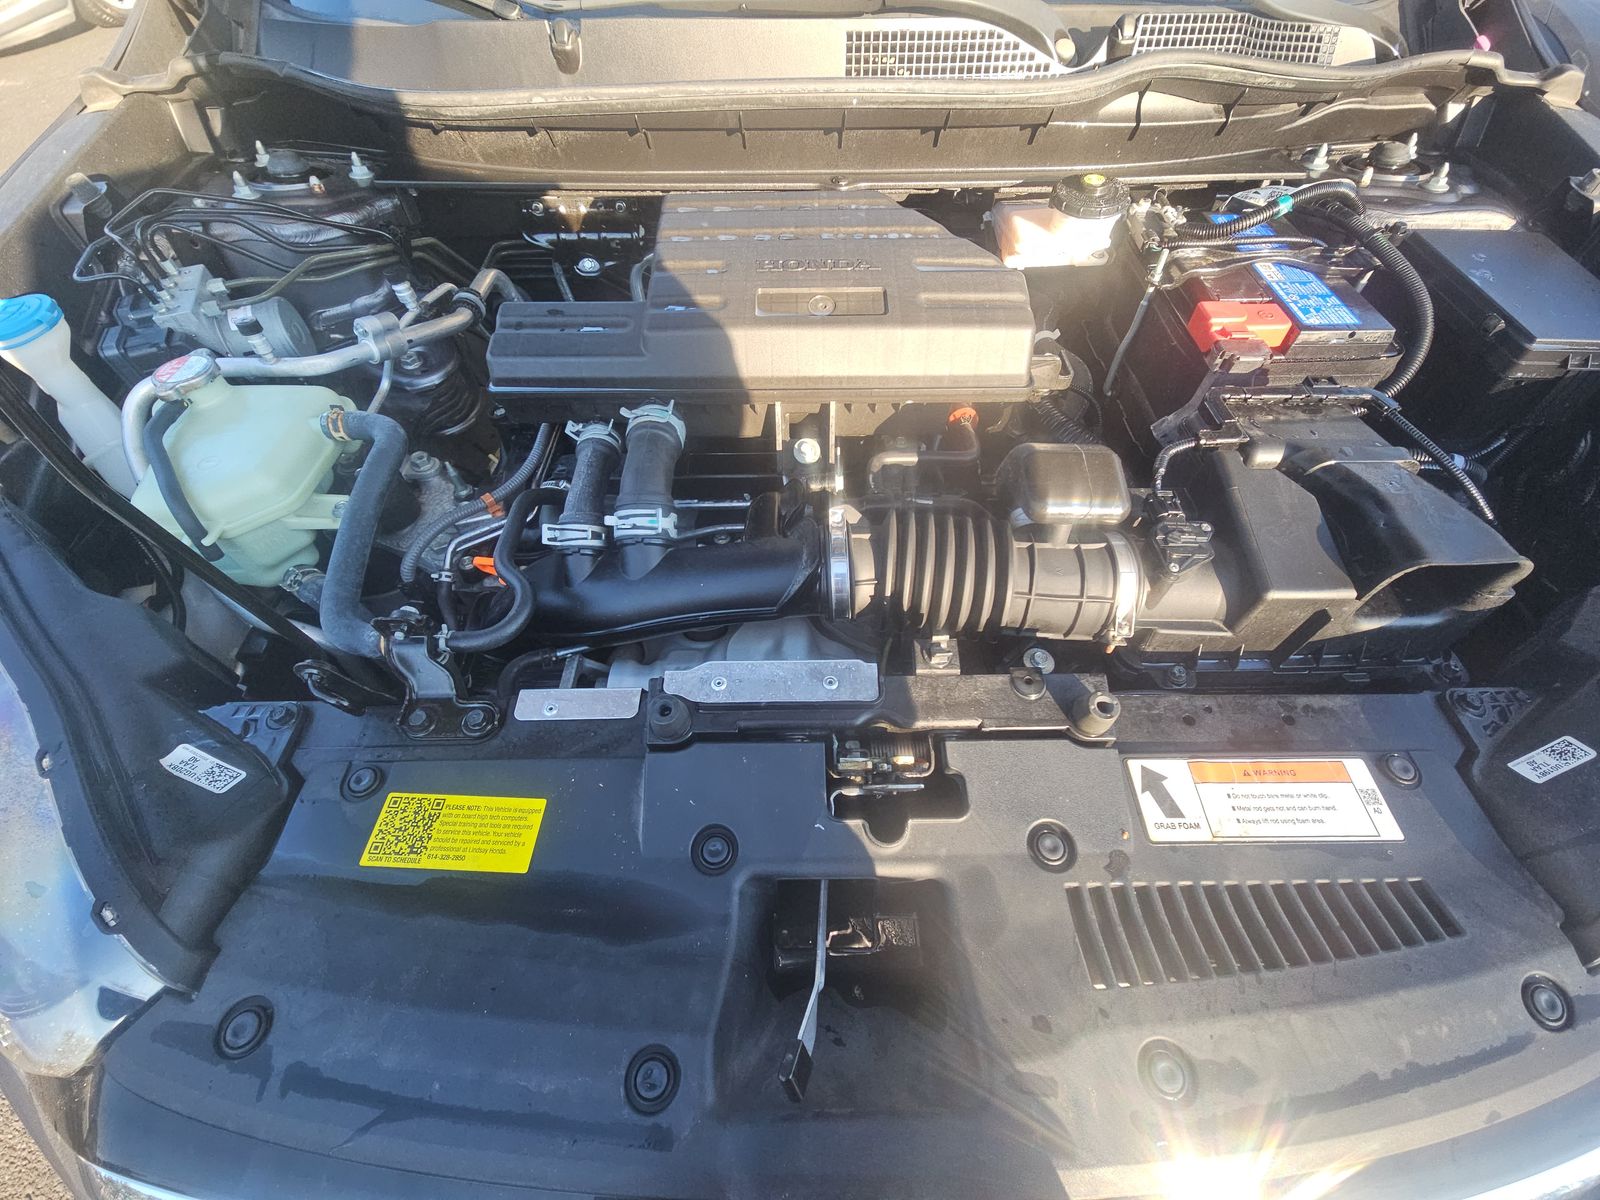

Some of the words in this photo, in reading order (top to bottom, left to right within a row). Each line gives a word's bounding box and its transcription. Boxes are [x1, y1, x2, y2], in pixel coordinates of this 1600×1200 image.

[756, 259, 881, 271] HONDA
[1530, 762, 1552, 772] TLAA
[392, 856, 421, 864] SCHEDULE
